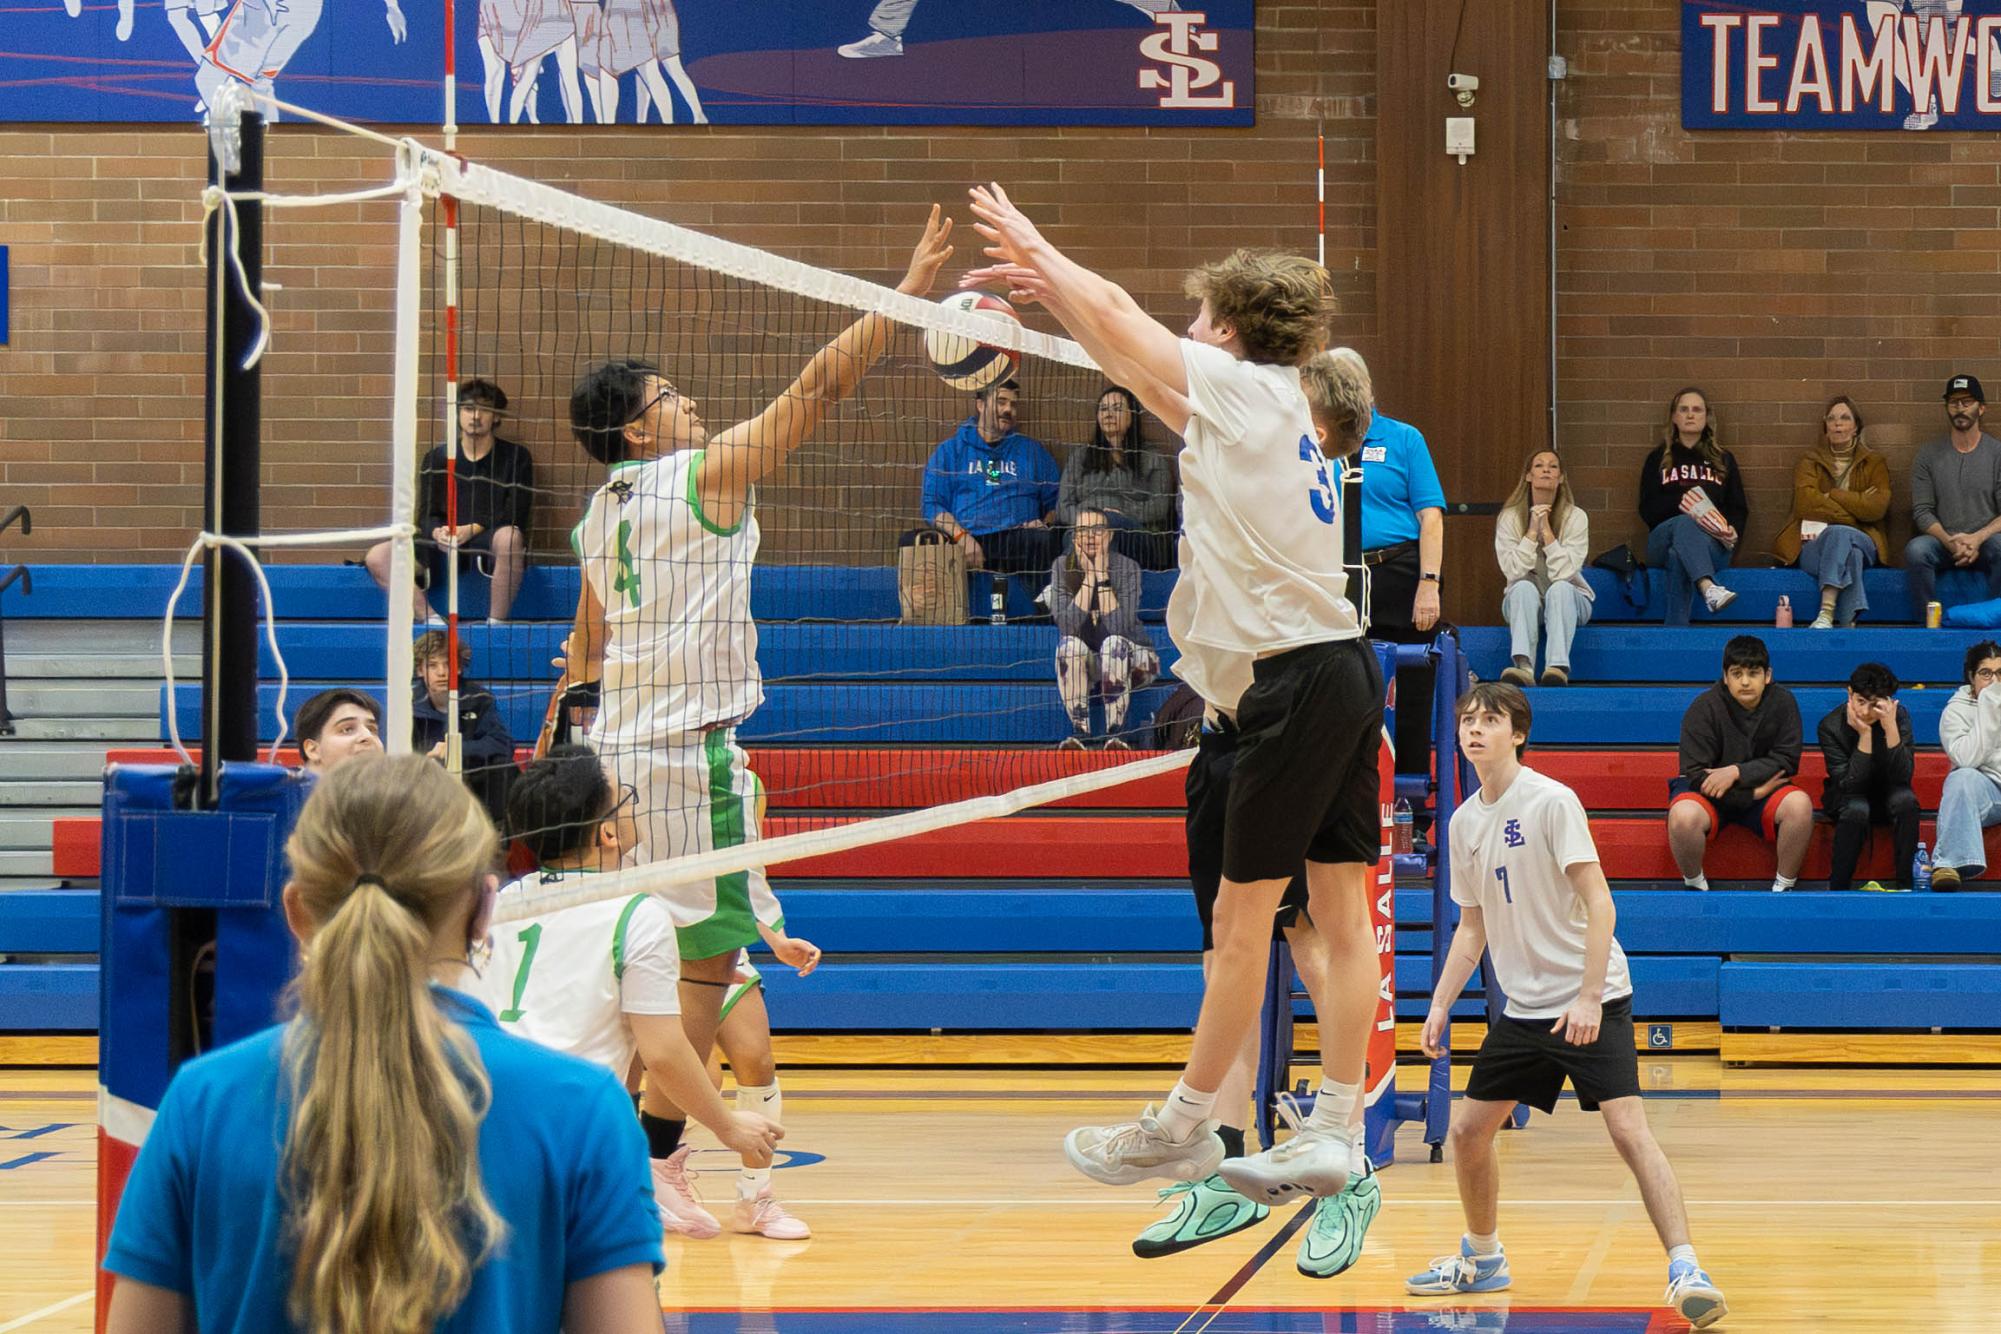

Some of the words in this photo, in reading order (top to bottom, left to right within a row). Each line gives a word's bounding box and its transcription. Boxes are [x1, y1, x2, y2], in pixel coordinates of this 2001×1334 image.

[1299, 434, 1335, 525] 3
[1376, 802, 1394, 954] SALLE
[1495, 865, 1512, 904] 7
[499, 922, 543, 1023] 1
[1377, 971, 1394, 1032] LA
